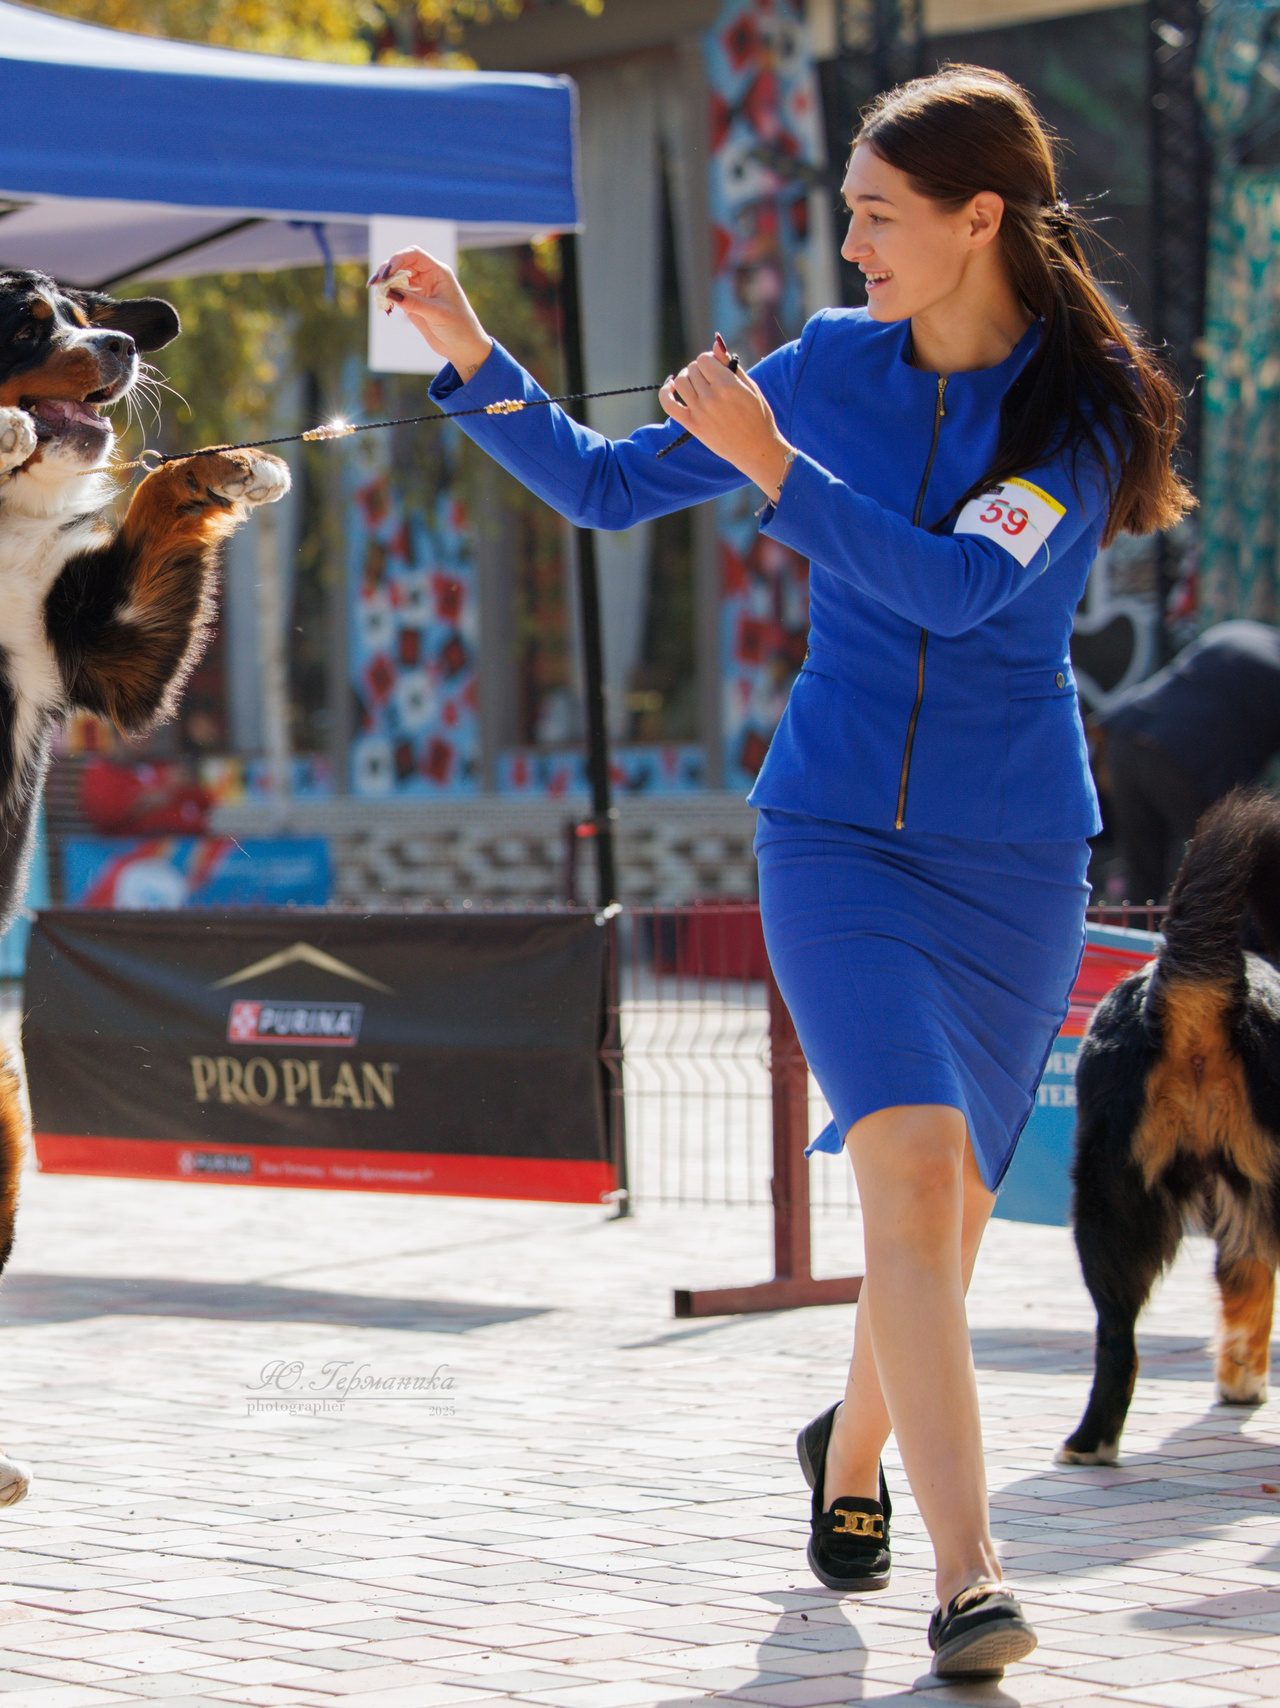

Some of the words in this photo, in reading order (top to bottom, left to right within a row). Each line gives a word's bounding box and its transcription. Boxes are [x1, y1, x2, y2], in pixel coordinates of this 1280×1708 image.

[980, 499, 1029, 535] 59
[258, 1008, 352, 1036] PURINA
[190, 1055, 278, 1107] PRO
[280, 1057, 395, 1111] PLAN
